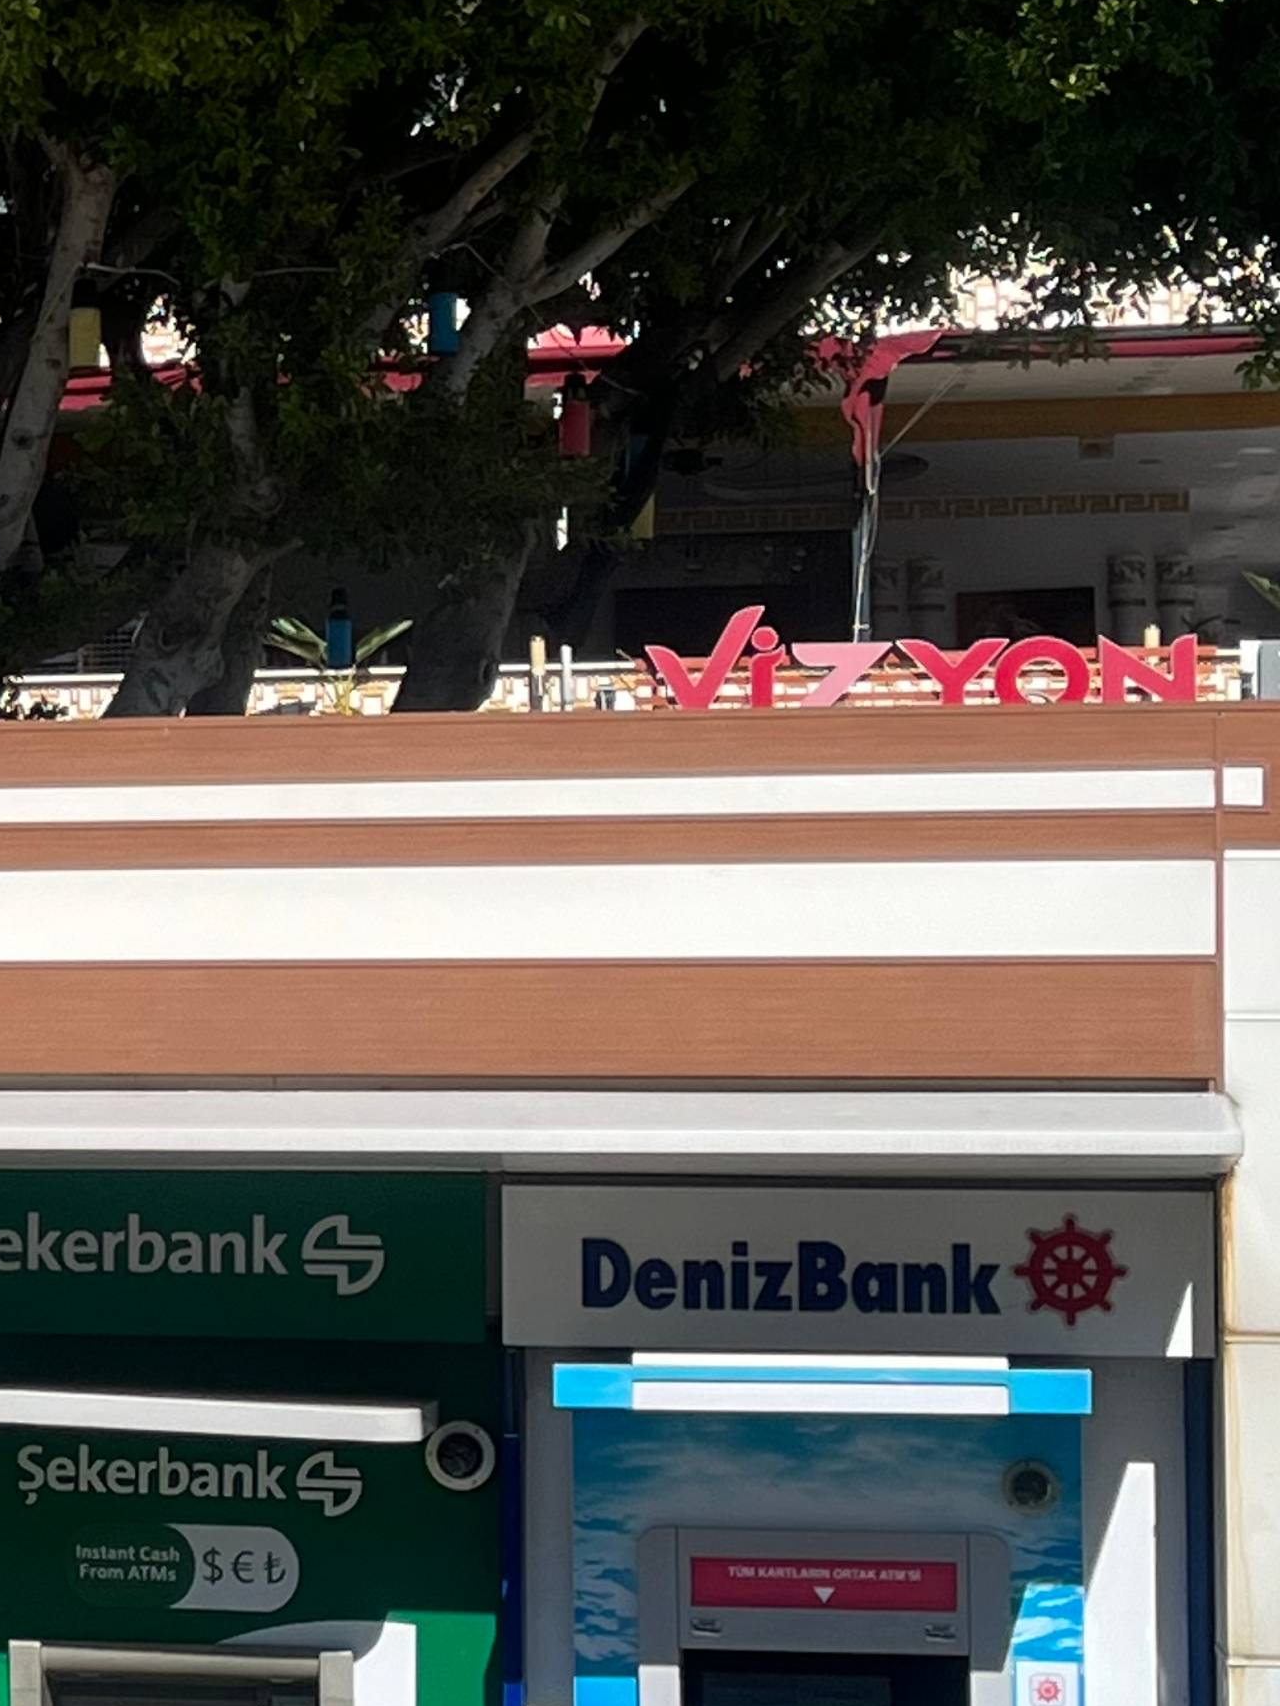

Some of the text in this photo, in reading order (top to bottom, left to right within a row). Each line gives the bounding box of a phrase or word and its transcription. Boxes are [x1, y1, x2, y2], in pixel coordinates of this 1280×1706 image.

[581, 1237, 1001, 1315] DenizBank
[17, 1444, 286, 1505] Şekerbank
[75, 1544, 181, 1562] Instant Cash
[80, 1564, 177, 1582] From ATMs
